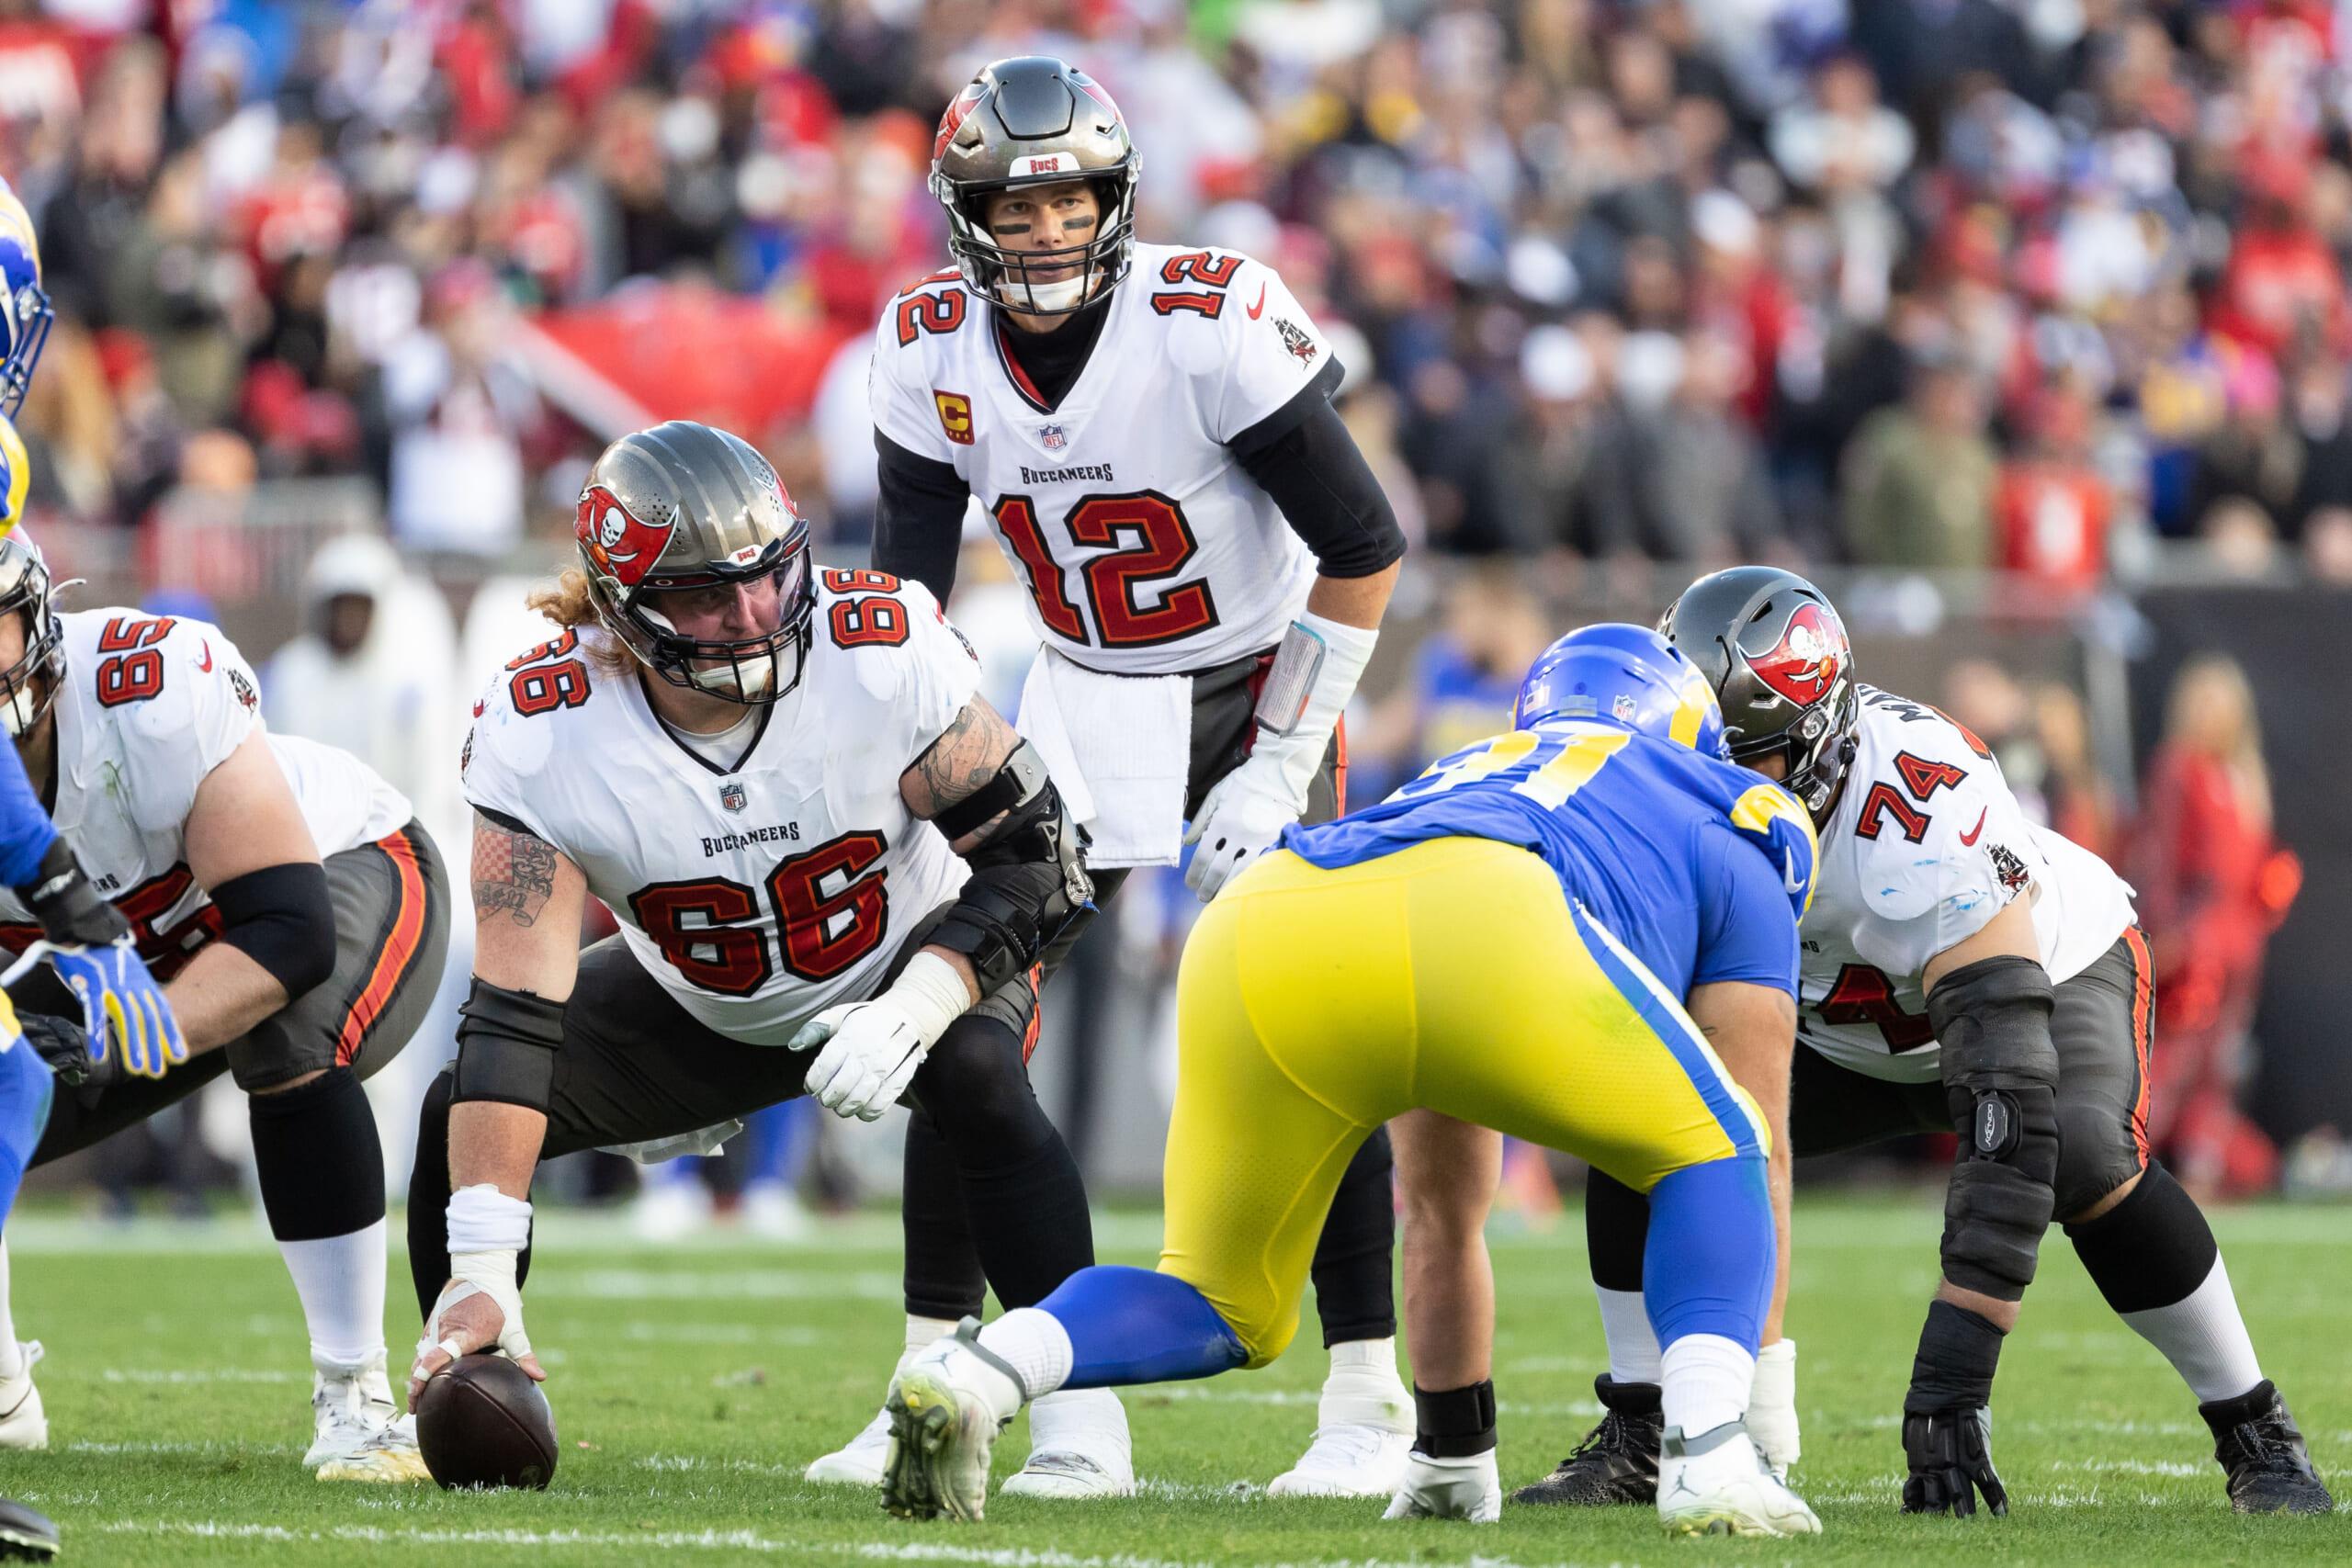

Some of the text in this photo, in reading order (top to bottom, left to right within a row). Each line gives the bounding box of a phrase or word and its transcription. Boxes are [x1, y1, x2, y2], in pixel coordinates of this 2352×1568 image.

[1029, 157, 1059, 175] BUCS
[1150, 251, 1245, 321] 12
[936, 394, 969, 433] C
[1044, 434, 1063, 447] NFL
[1020, 463, 1114, 485] BUCCANEERS
[990, 488, 1221, 649] 12
[96, 616, 178, 709] 65
[724, 794, 744, 809] NFL
[1854, 750, 1969, 845] 74
[700, 821, 800, 858] BUCCANEERS
[627, 829, 889, 998] 66
[1798, 963, 1937, 1055] 4
